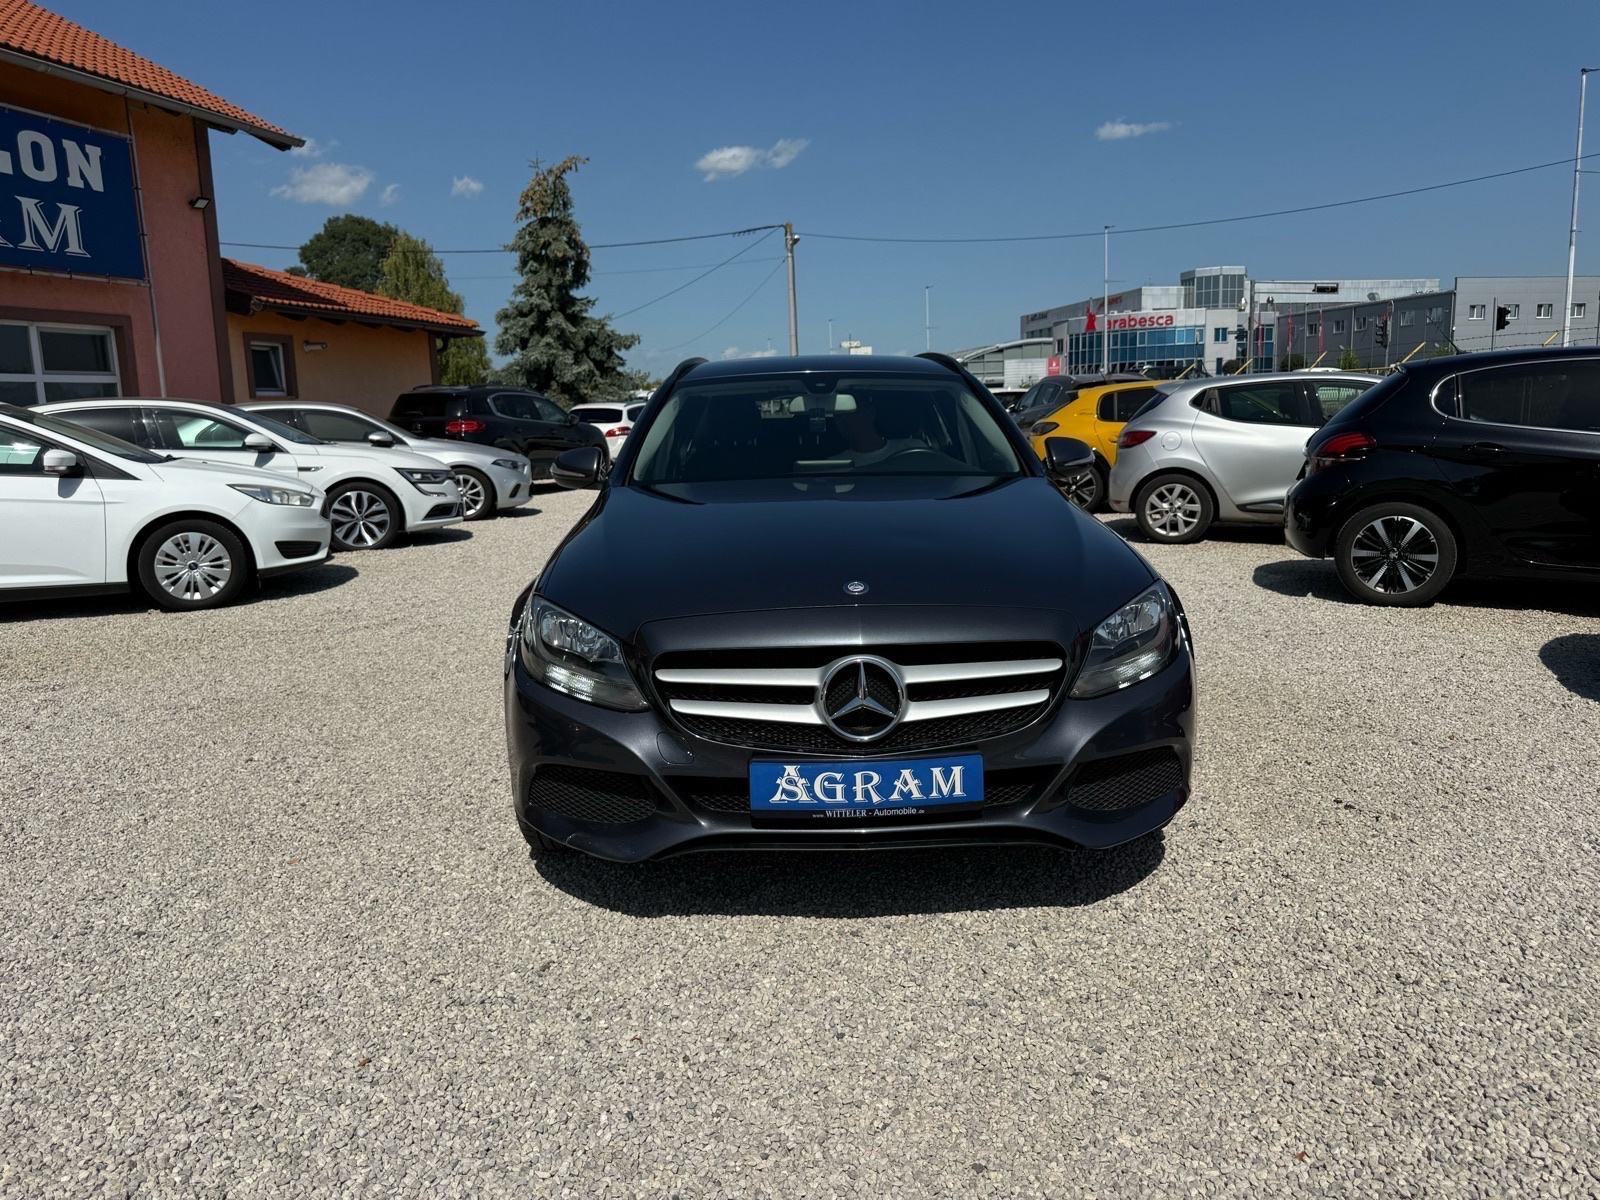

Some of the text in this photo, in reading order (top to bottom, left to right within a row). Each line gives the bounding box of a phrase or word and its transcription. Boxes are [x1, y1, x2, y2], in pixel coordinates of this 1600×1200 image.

[0, 195, 91, 258] M
[825, 809, 867, 818] WITTELER
[873, 806, 917, 817] Automobile
